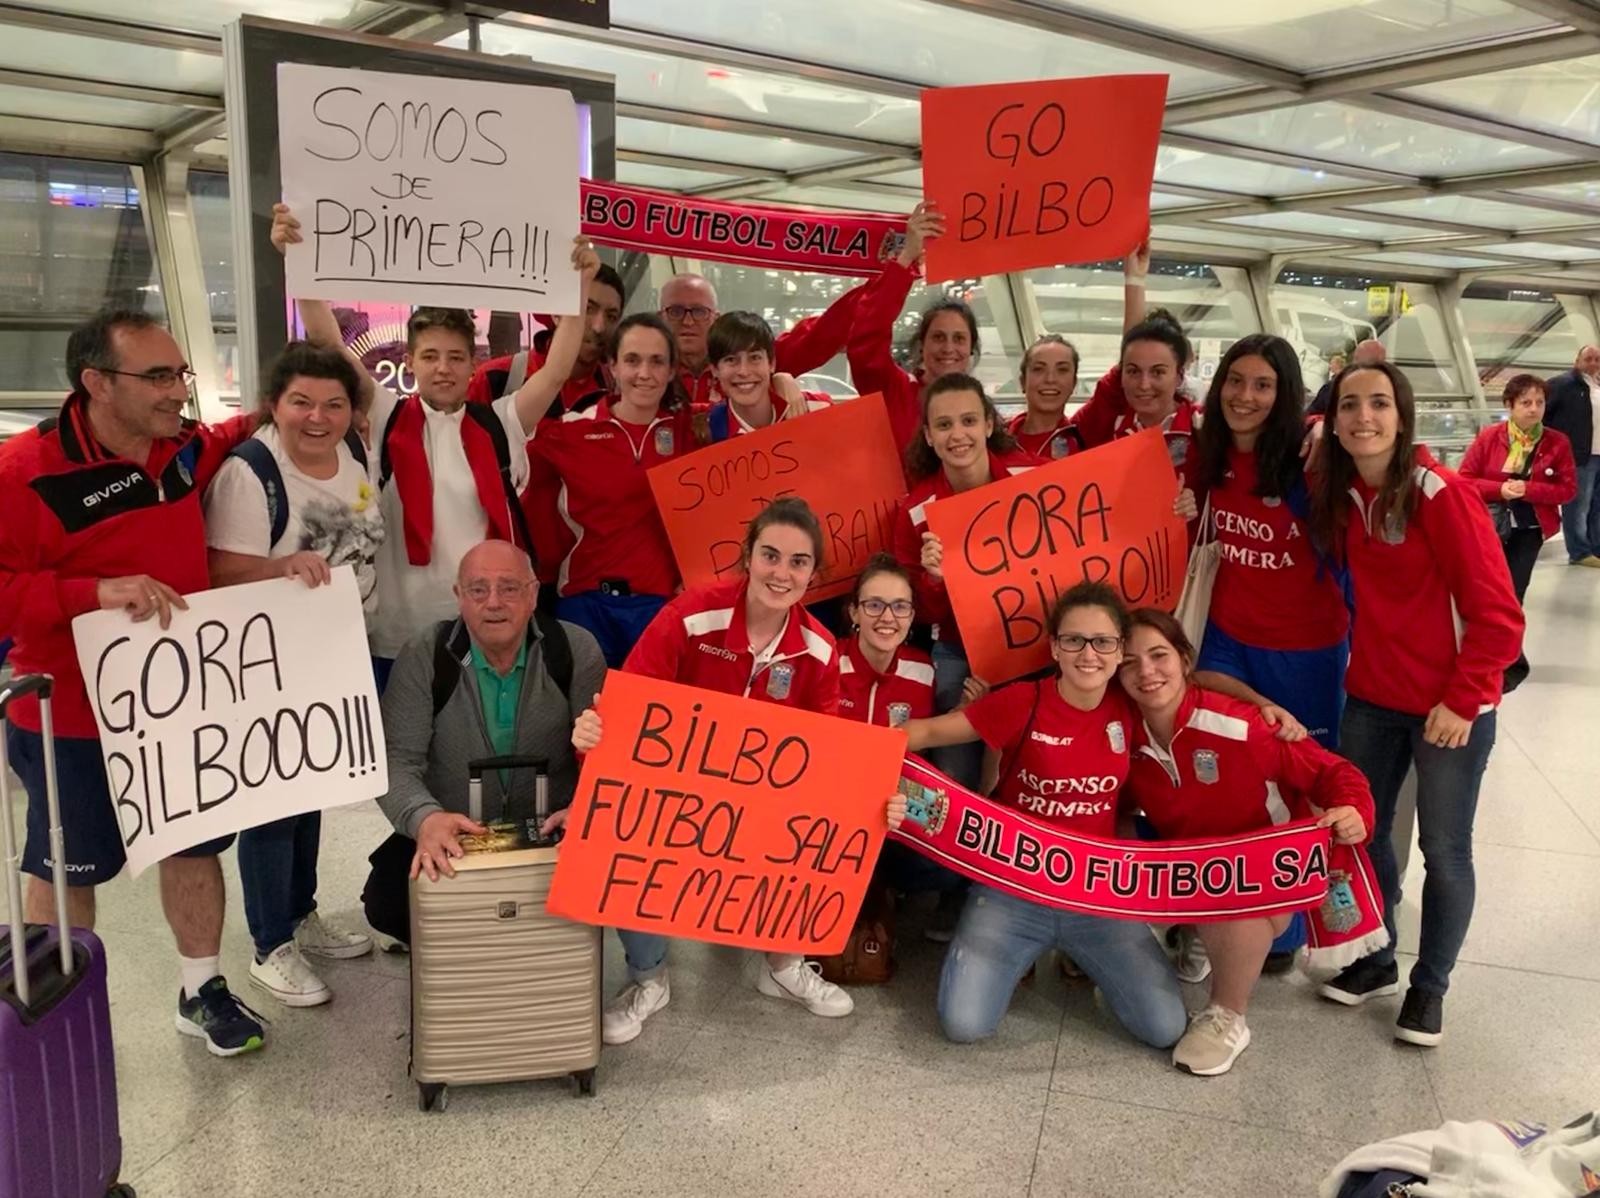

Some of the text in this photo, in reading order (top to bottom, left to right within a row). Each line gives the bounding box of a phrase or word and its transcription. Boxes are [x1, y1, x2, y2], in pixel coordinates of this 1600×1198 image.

[304, 86, 507, 165] SOMOS
[986, 102, 1066, 167] GO
[370, 173, 433, 200] DE
[783, 220, 870, 259] SALA
[82, 472, 143, 507] GIVOVA
[673, 440, 799, 511] SOMOS
[964, 482, 1112, 576] GORA
[1211, 506, 1301, 542] CENSO A
[1221, 543, 1295, 570] IMERA
[97, 613, 282, 733] GORA
[1017, 768, 1118, 795] ASCENSO
[581, 778, 869, 875] FUTBOL SALA
[955, 806, 1075, 886] BILBO
[1084, 852, 1263, 899] FÚTBOL
